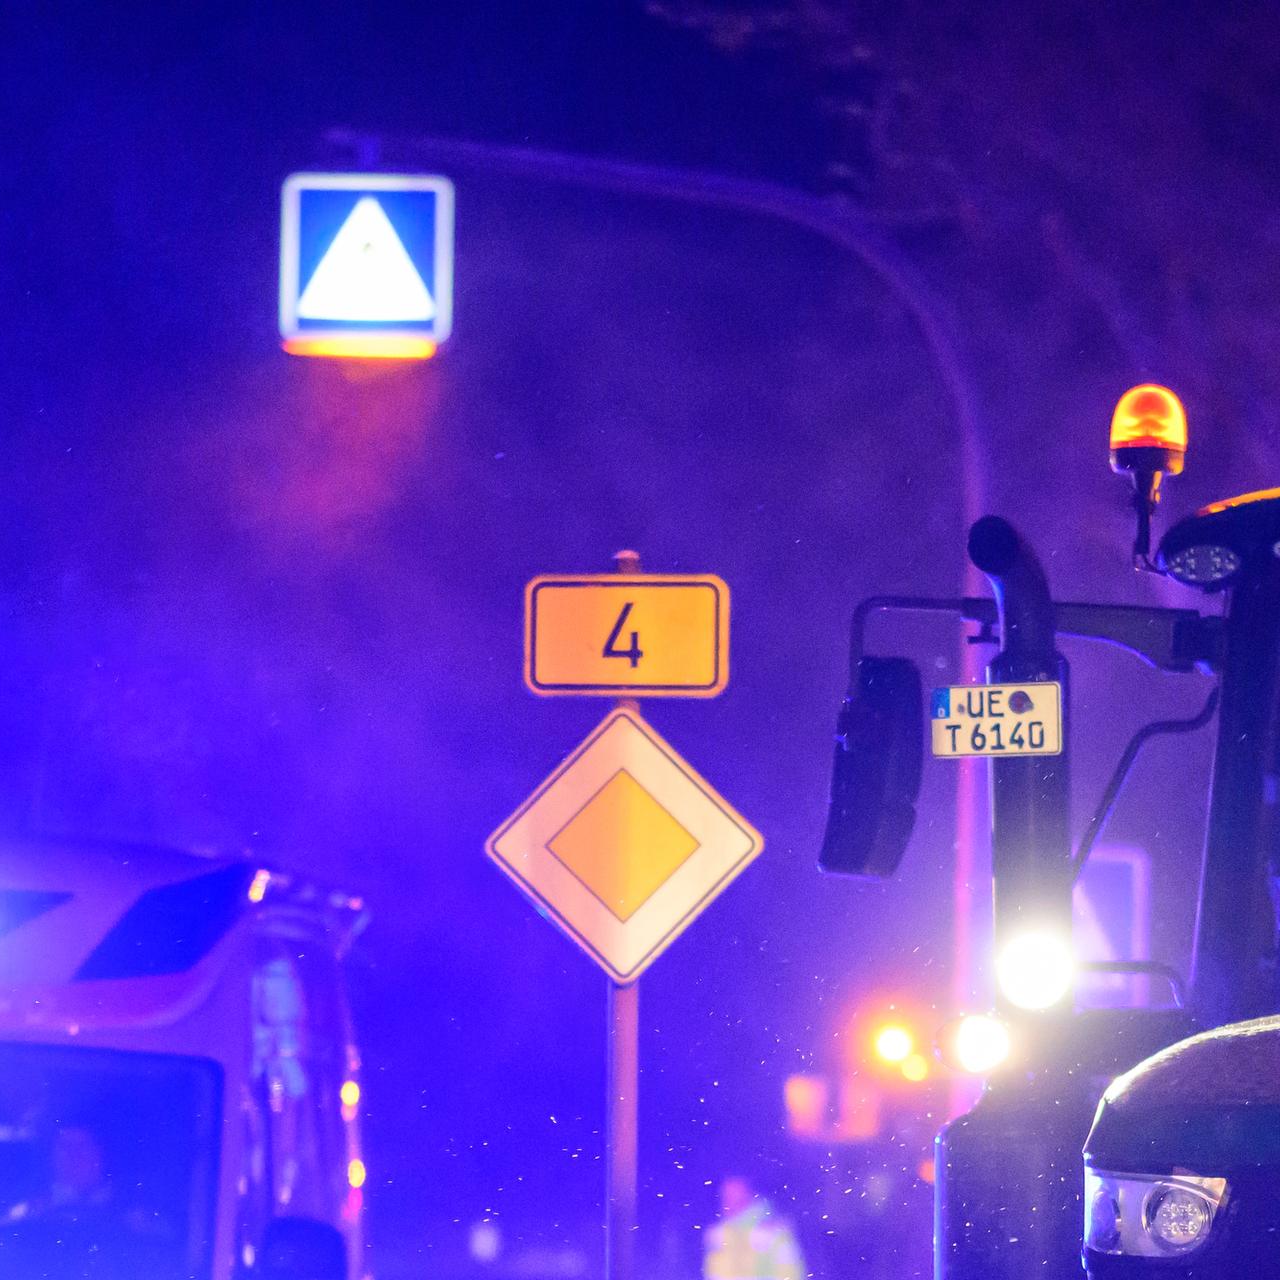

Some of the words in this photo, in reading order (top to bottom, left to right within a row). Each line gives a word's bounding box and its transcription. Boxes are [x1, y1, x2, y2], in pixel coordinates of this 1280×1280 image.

[602, 602, 643, 668] 4
[967, 690, 1005, 718] UE
[945, 724, 962, 752] T
[970, 721, 1045, 751] 6140
